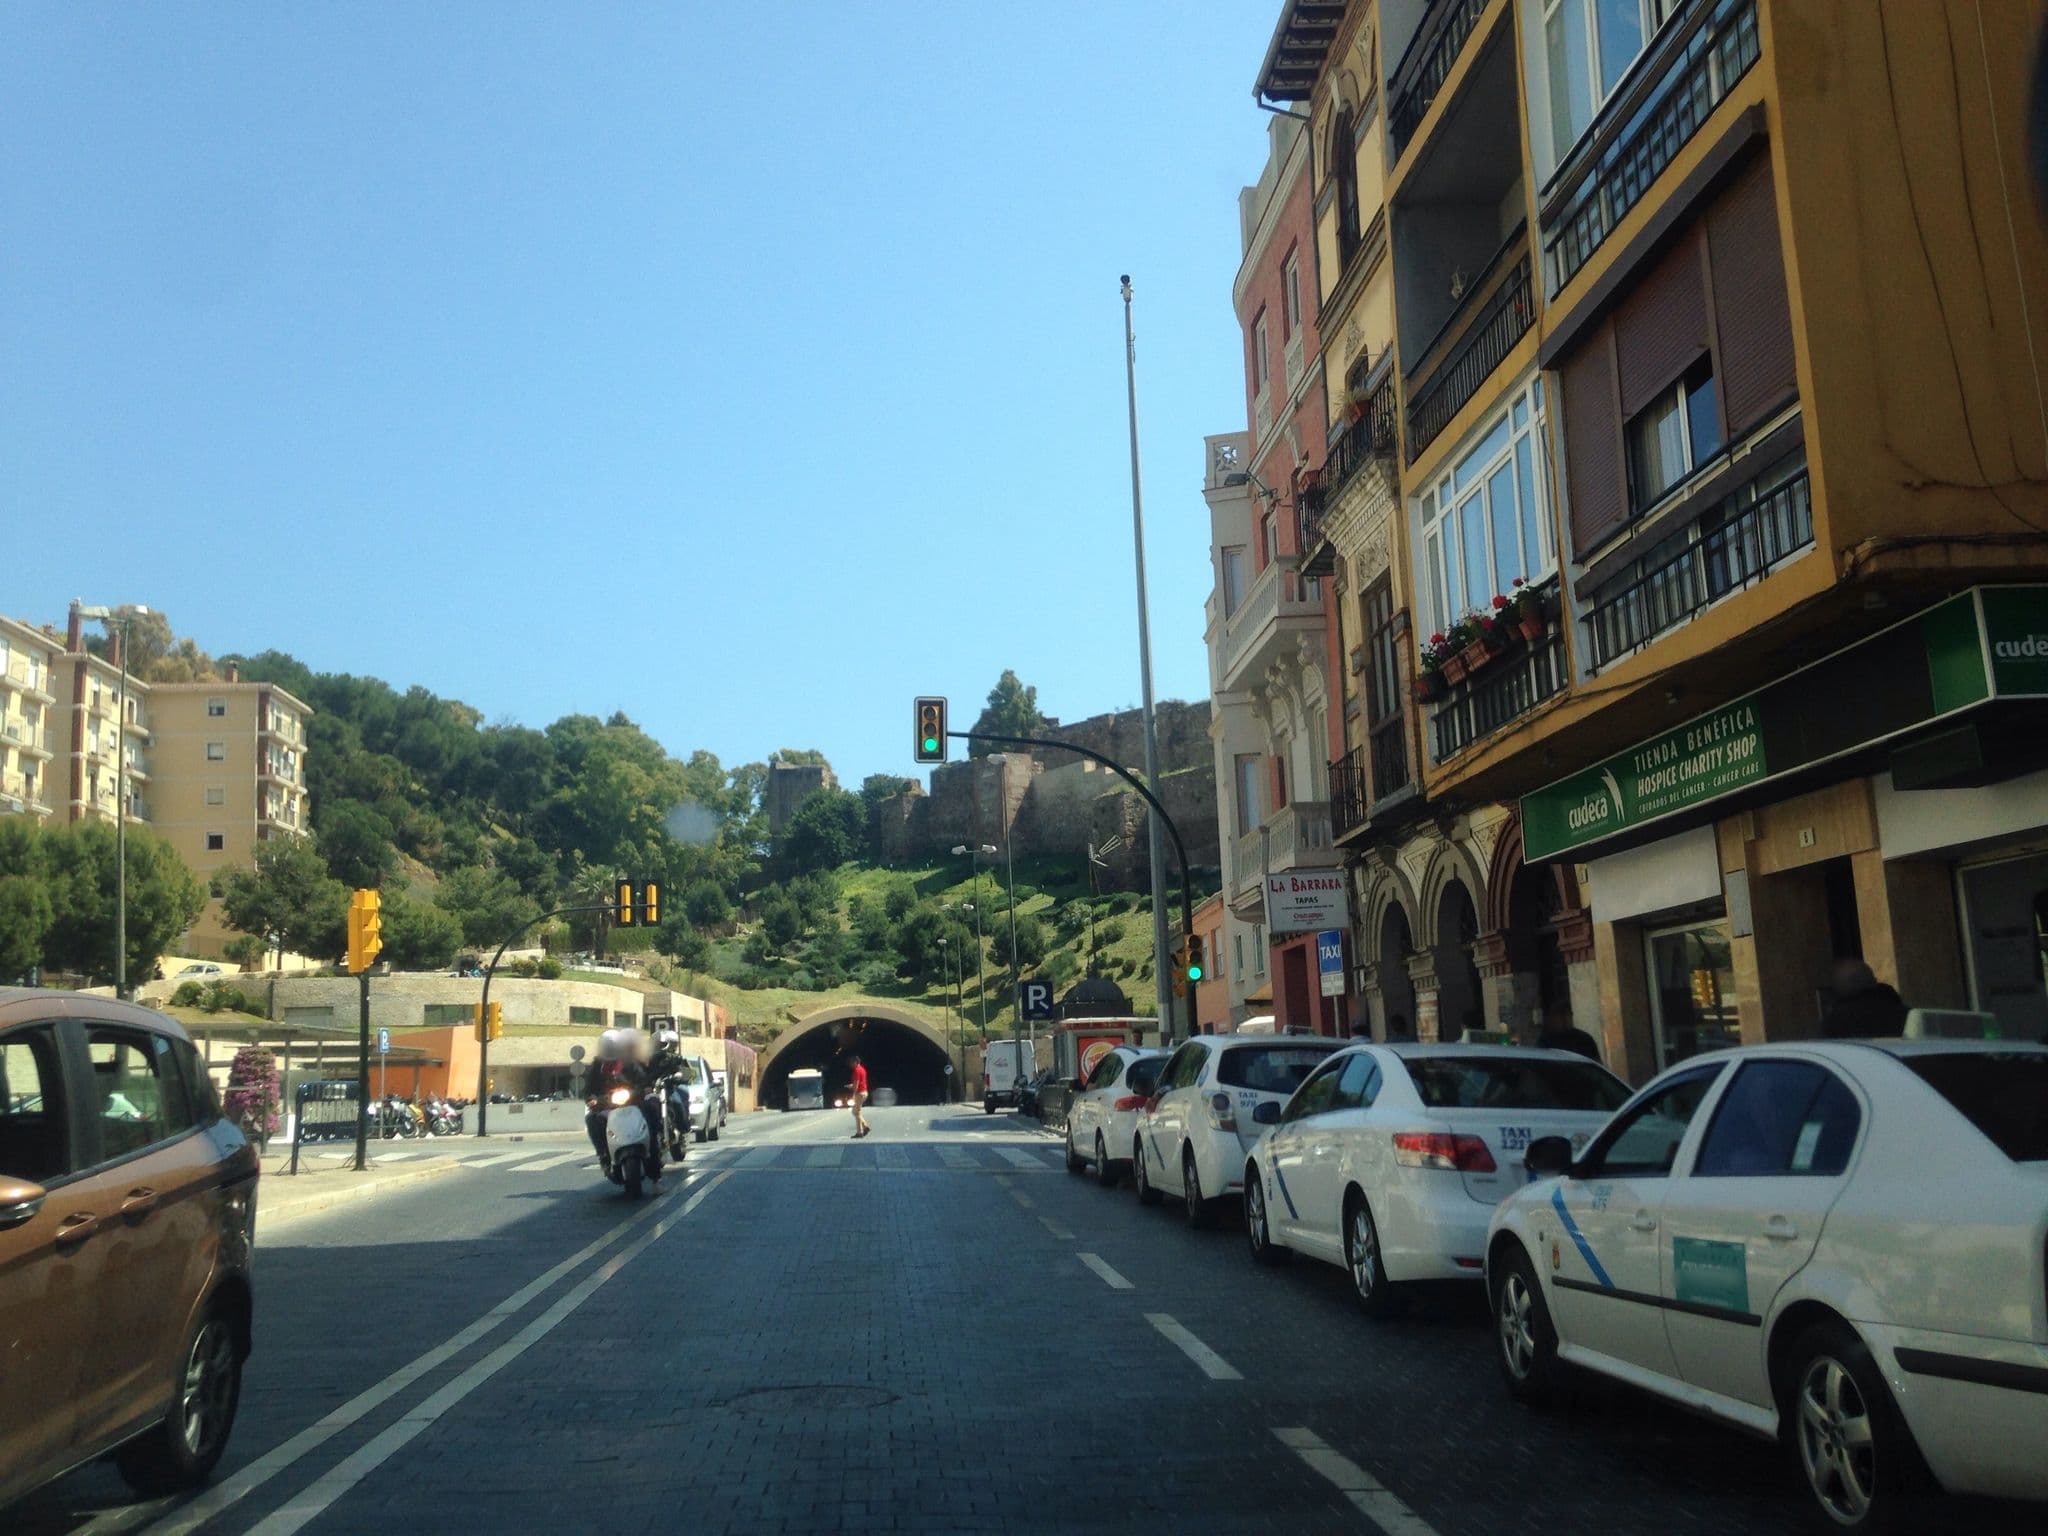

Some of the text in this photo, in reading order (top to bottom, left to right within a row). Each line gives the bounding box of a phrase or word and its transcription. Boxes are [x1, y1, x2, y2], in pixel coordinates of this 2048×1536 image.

[1634, 706, 1754, 774] TIENDA BENÉFICA
[1638, 733, 1757, 797] HOSPICE CHARITY SHOP
[1669, 791, 1680, 803] DEL
[1713, 769, 1739, 787] CANCER
[1742, 761, 1759, 777] CARE
[1568, 796, 1608, 829] cudeca
[1271, 879, 1286, 893] LA
[1295, 896, 1319, 904] TAPAS
[1320, 944, 1341, 960] TAXI
[1239, 1091, 1258, 1099] TAXI
[1499, 1127, 1532, 1139] TAXI
